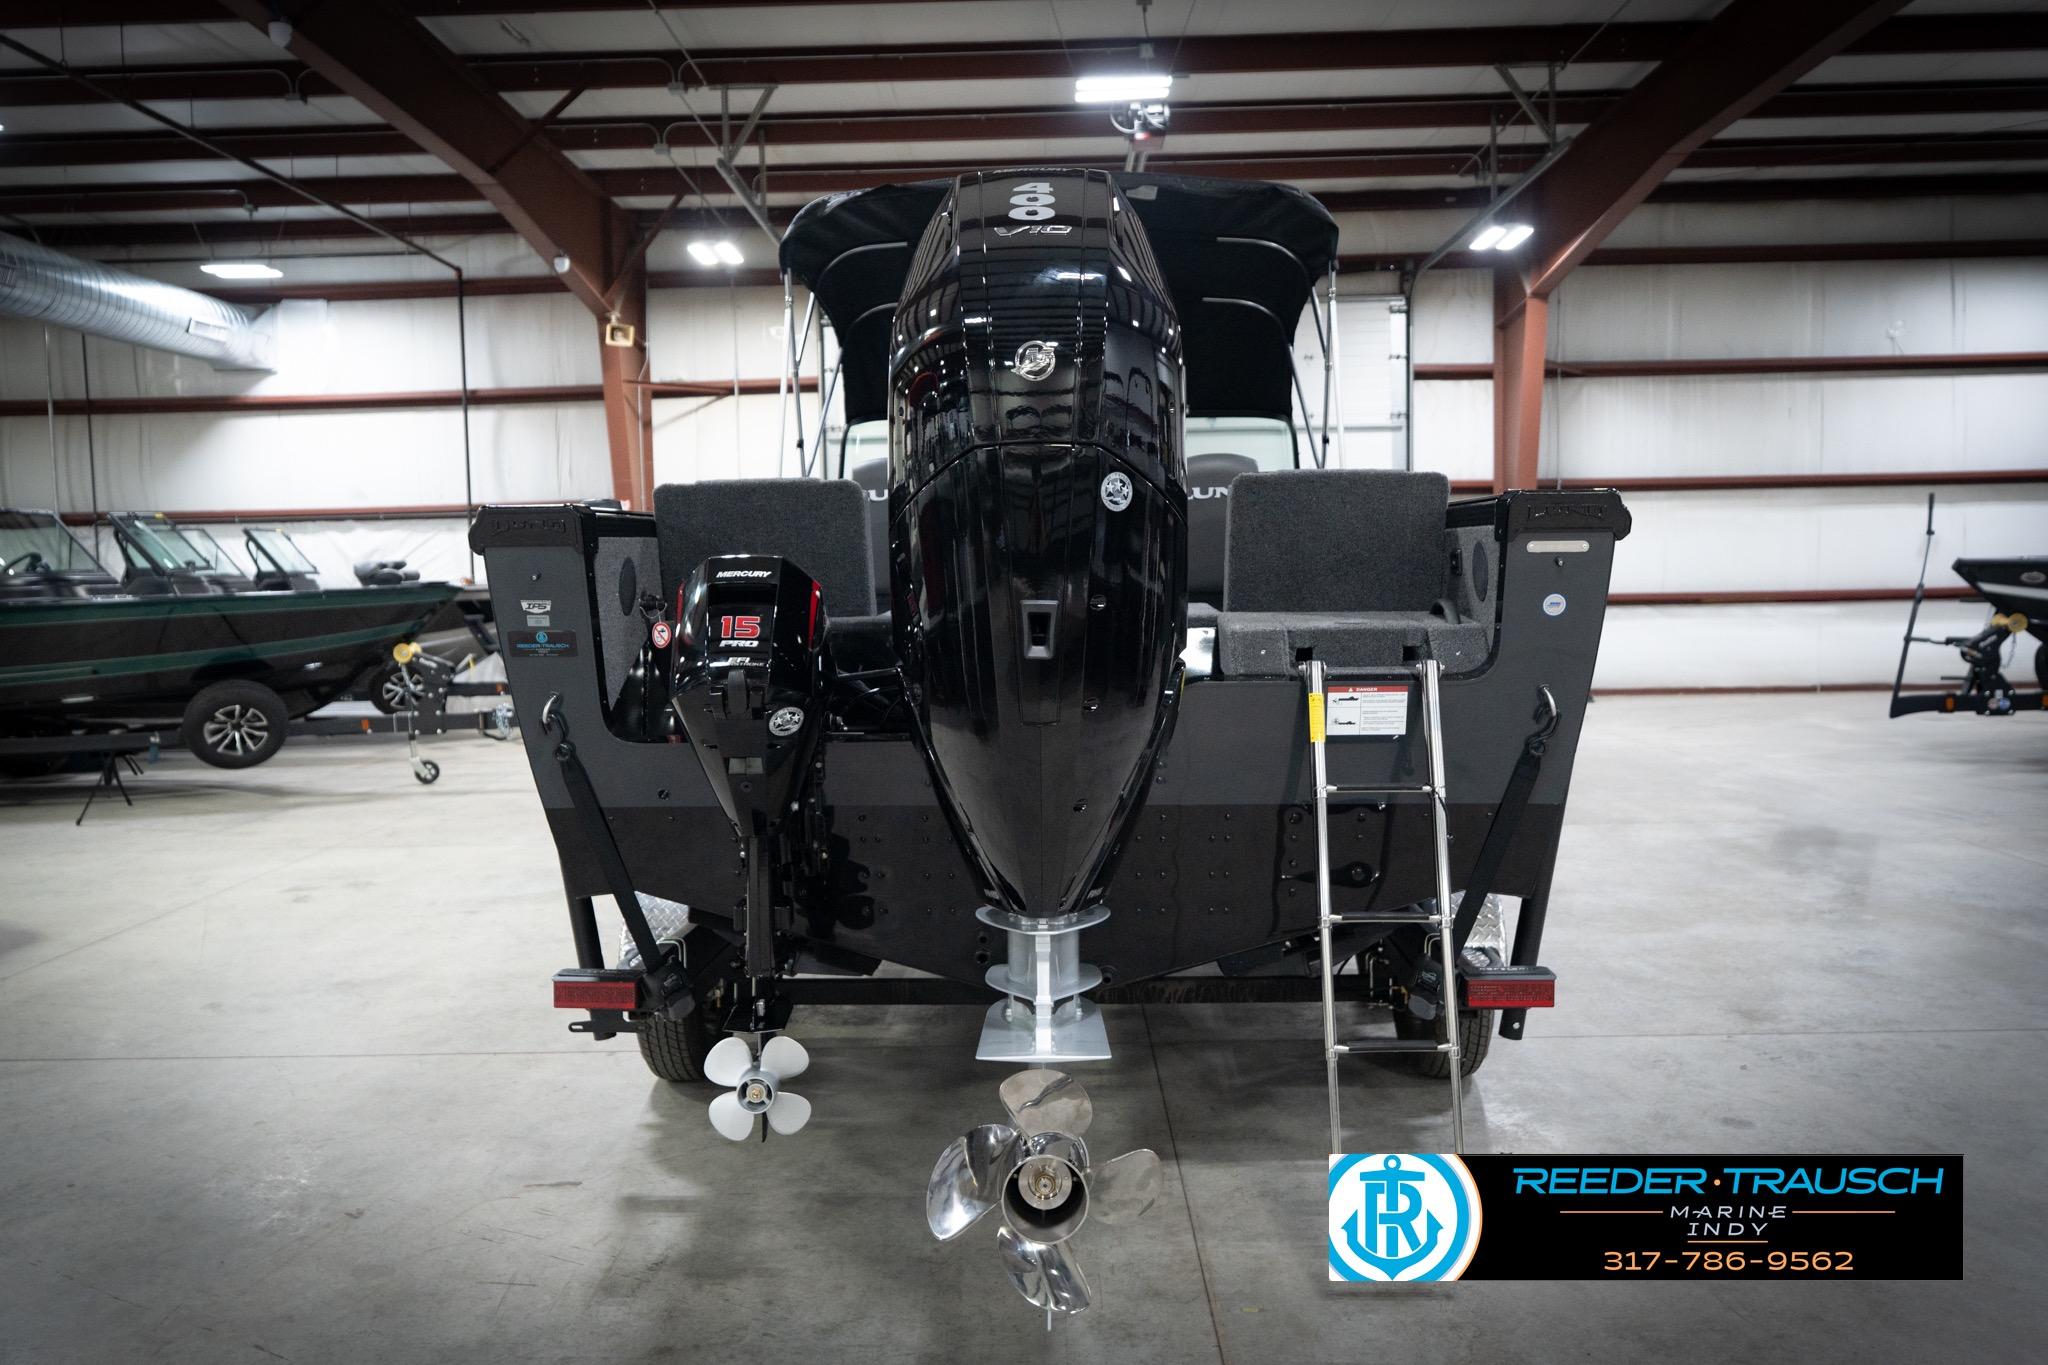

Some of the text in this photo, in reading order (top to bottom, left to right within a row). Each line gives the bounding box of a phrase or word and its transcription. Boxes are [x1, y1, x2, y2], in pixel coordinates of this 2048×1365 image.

[1008, 182, 1056, 221] 400
[993, 225, 1073, 237] V10
[716, 570, 773, 578] MERCURY
[721, 615, 761, 639] 15
[719, 640, 760, 648] PRO
